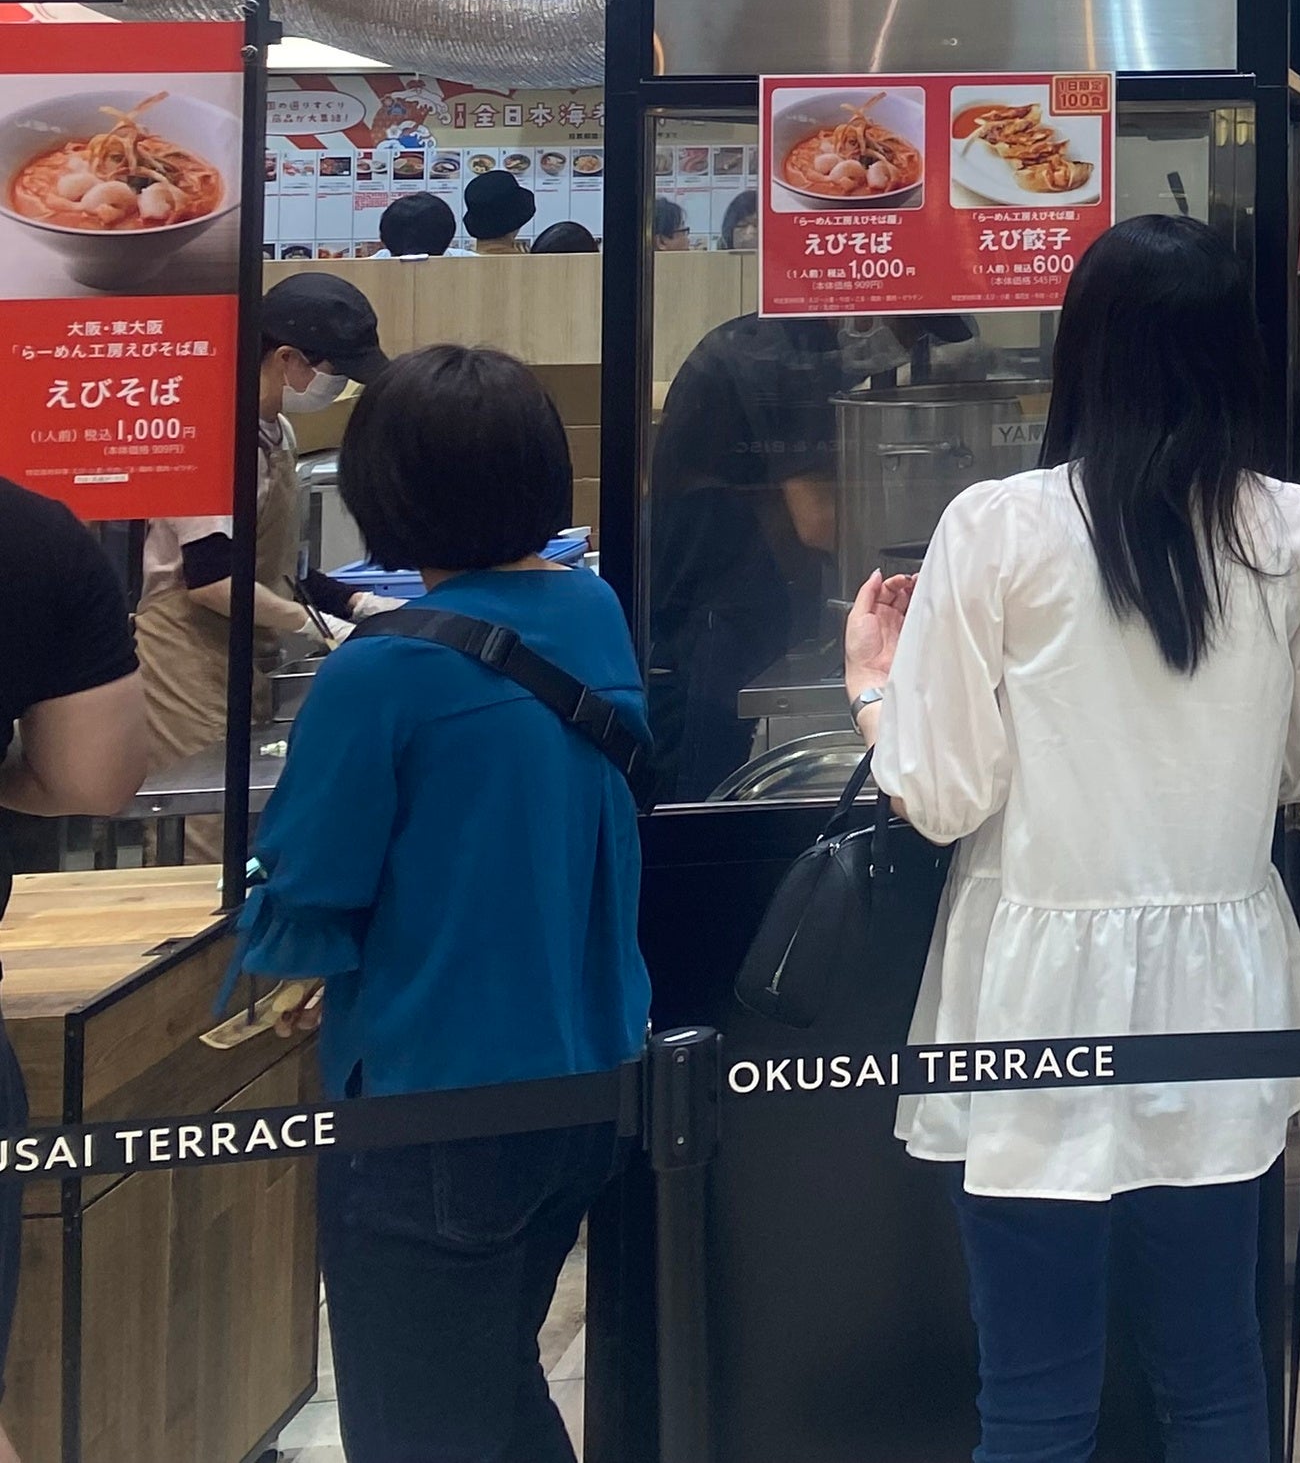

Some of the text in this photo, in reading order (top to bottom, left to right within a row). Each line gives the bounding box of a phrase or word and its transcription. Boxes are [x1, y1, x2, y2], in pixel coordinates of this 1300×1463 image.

[804, 231, 893, 255] えびそば
[979, 227, 1072, 251] えび餃子
[67, 320, 164, 337] 大阪・東大阪
[11, 340, 218, 361] 「らーめん工房えびそば屋」
[46, 374, 183, 409] えびそば
[728, 1045, 1115, 1094] OKUSAI TERRACE
[115, 1111, 336, 1164] TERRACE
